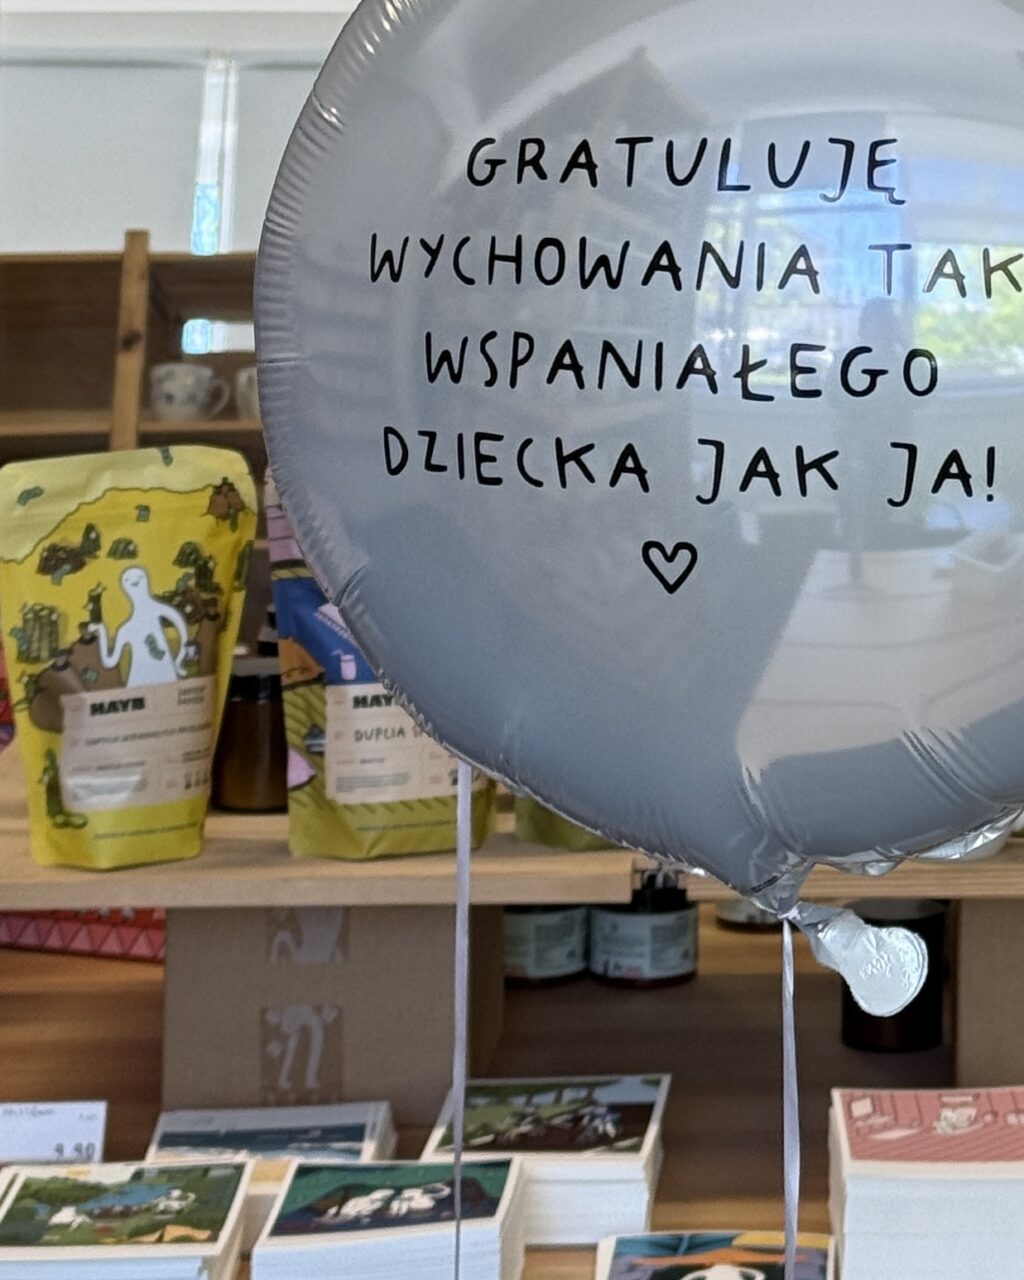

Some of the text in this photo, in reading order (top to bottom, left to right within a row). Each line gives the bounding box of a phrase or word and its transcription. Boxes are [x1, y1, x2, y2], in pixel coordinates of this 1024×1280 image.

[466, 136, 906, 205] GRATULUJĘ
[370, 232, 1023, 298] WYCHOWANIA TAK
[424, 330, 939, 402] WSPANIAŁEGO
[383, 425, 997, 508] DZIECKA JAK JA!
[352, 693, 394, 710] HAY
